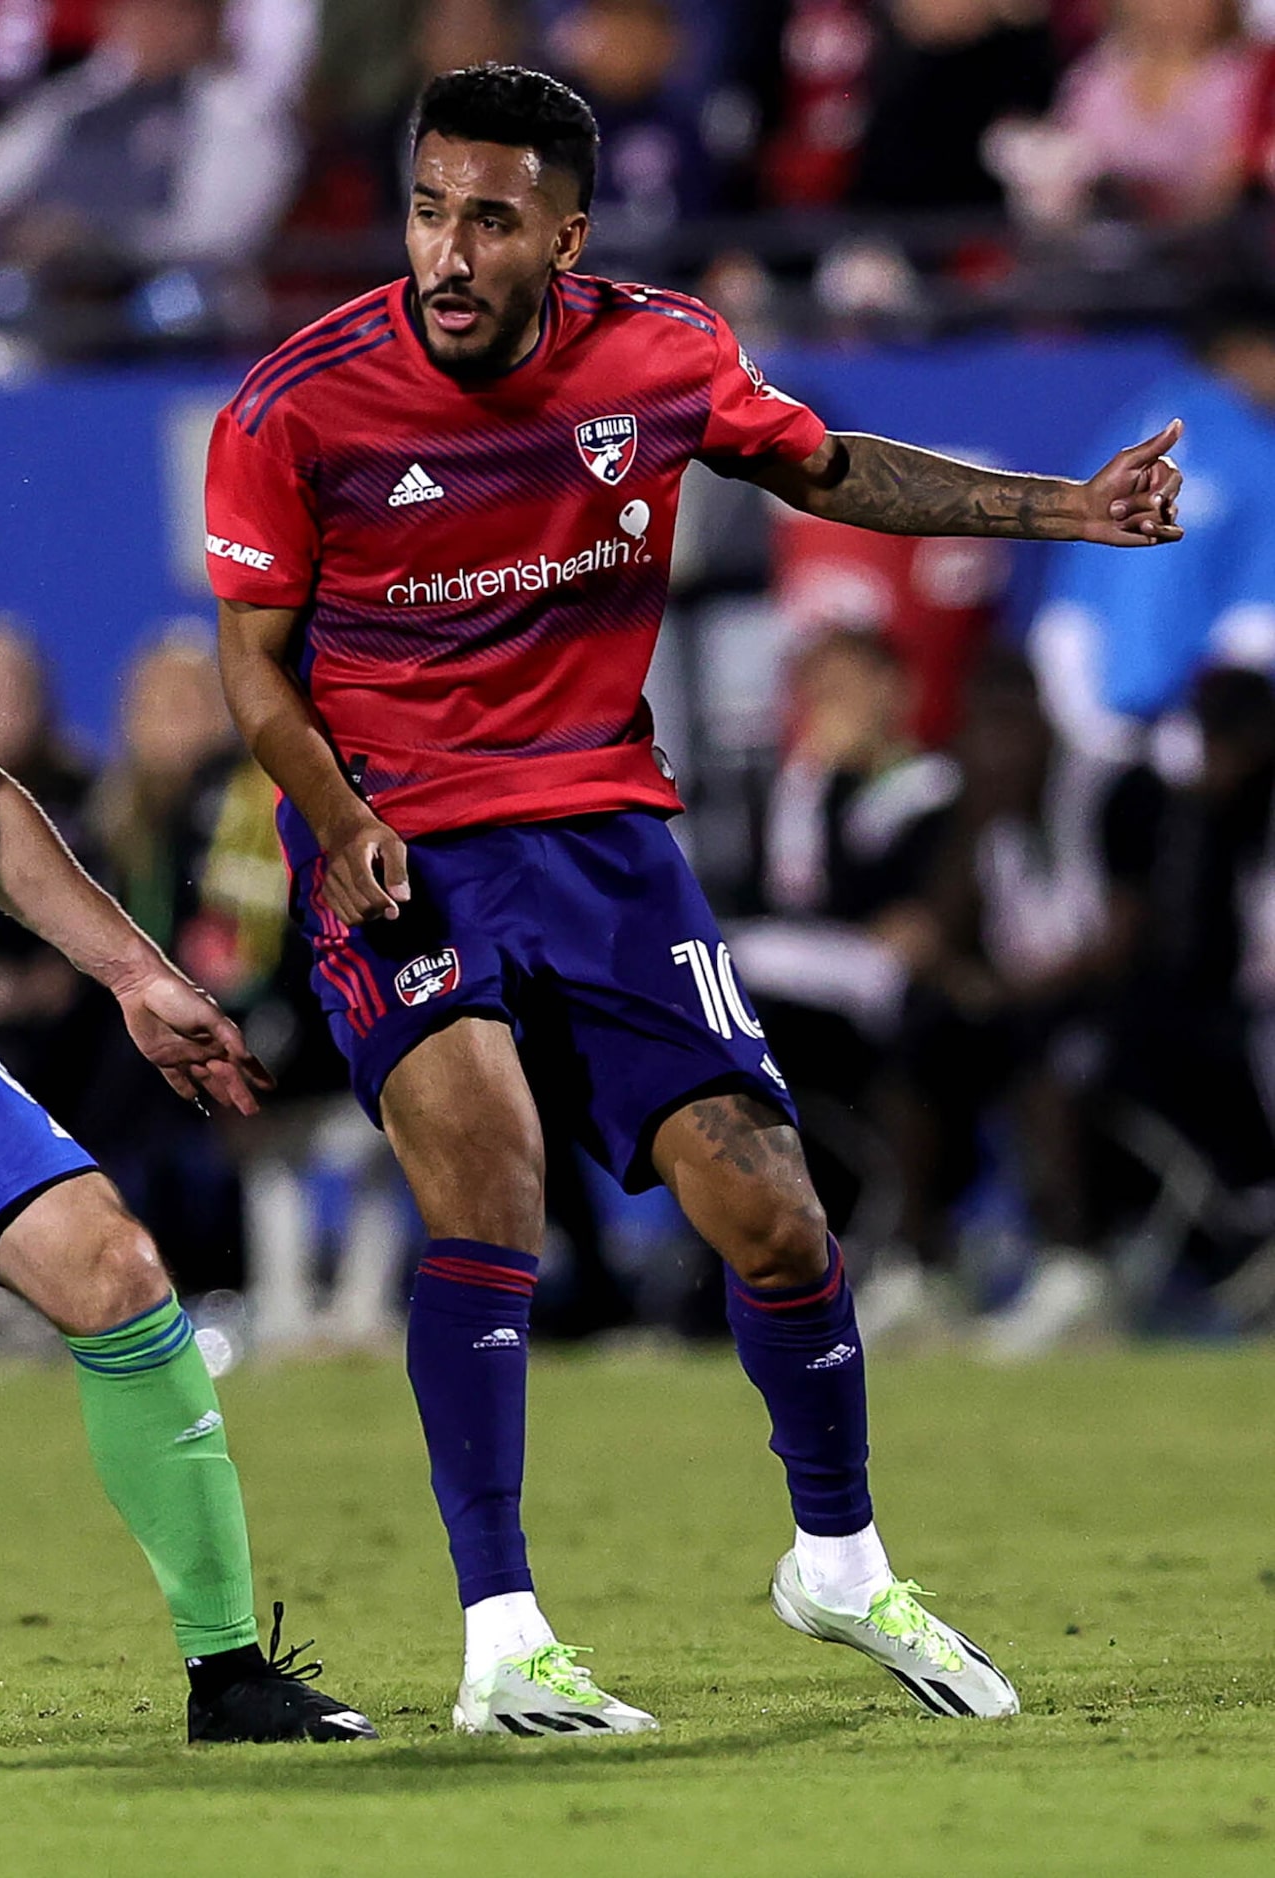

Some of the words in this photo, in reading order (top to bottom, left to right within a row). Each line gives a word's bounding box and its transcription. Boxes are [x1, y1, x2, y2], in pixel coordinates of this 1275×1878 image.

[580, 425, 593, 444] FC
[594, 418, 632, 439] DALLAS
[388, 484, 445, 507] adidas
[399, 970, 412, 988] FC
[412, 952, 453, 978] DALLAS
[670, 938, 765, 1040] 10
